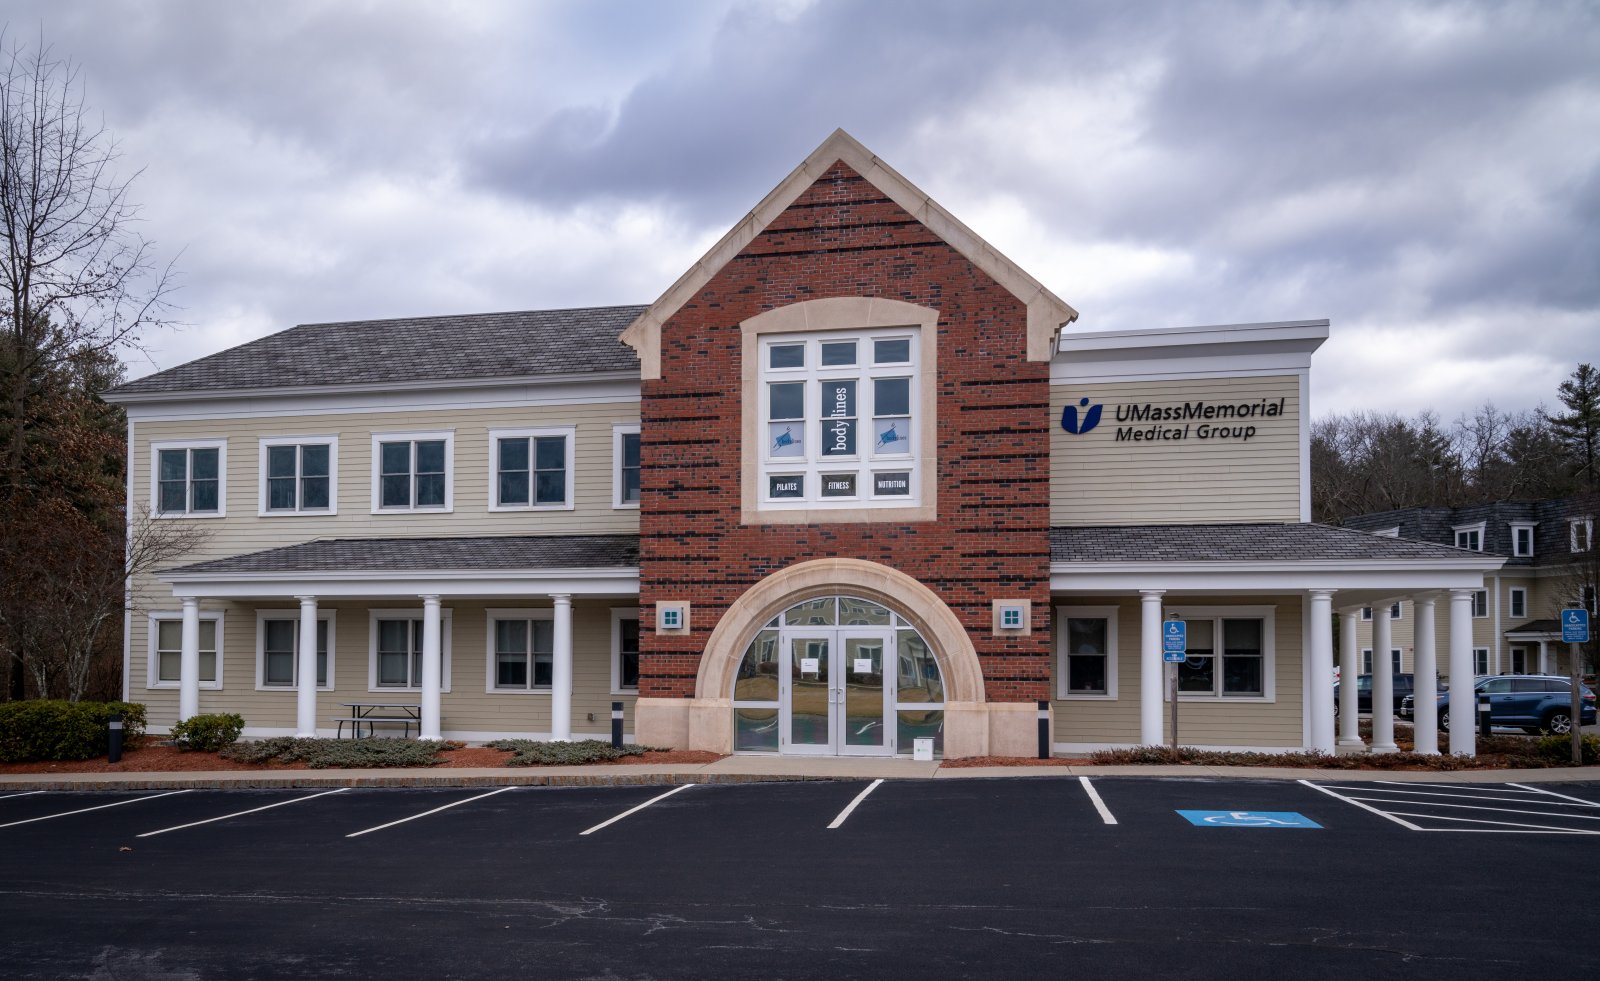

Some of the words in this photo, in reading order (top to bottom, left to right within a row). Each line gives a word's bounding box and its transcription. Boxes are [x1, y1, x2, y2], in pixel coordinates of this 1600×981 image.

[831, 387, 849, 451] bodylines
[1116, 425, 1189, 441] Medical
[1197, 425, 1256, 441] Group
[777, 482, 797, 491] PILATES
[828, 481, 849, 490] FITNESS
[878, 480, 906, 489] NUTRITION
